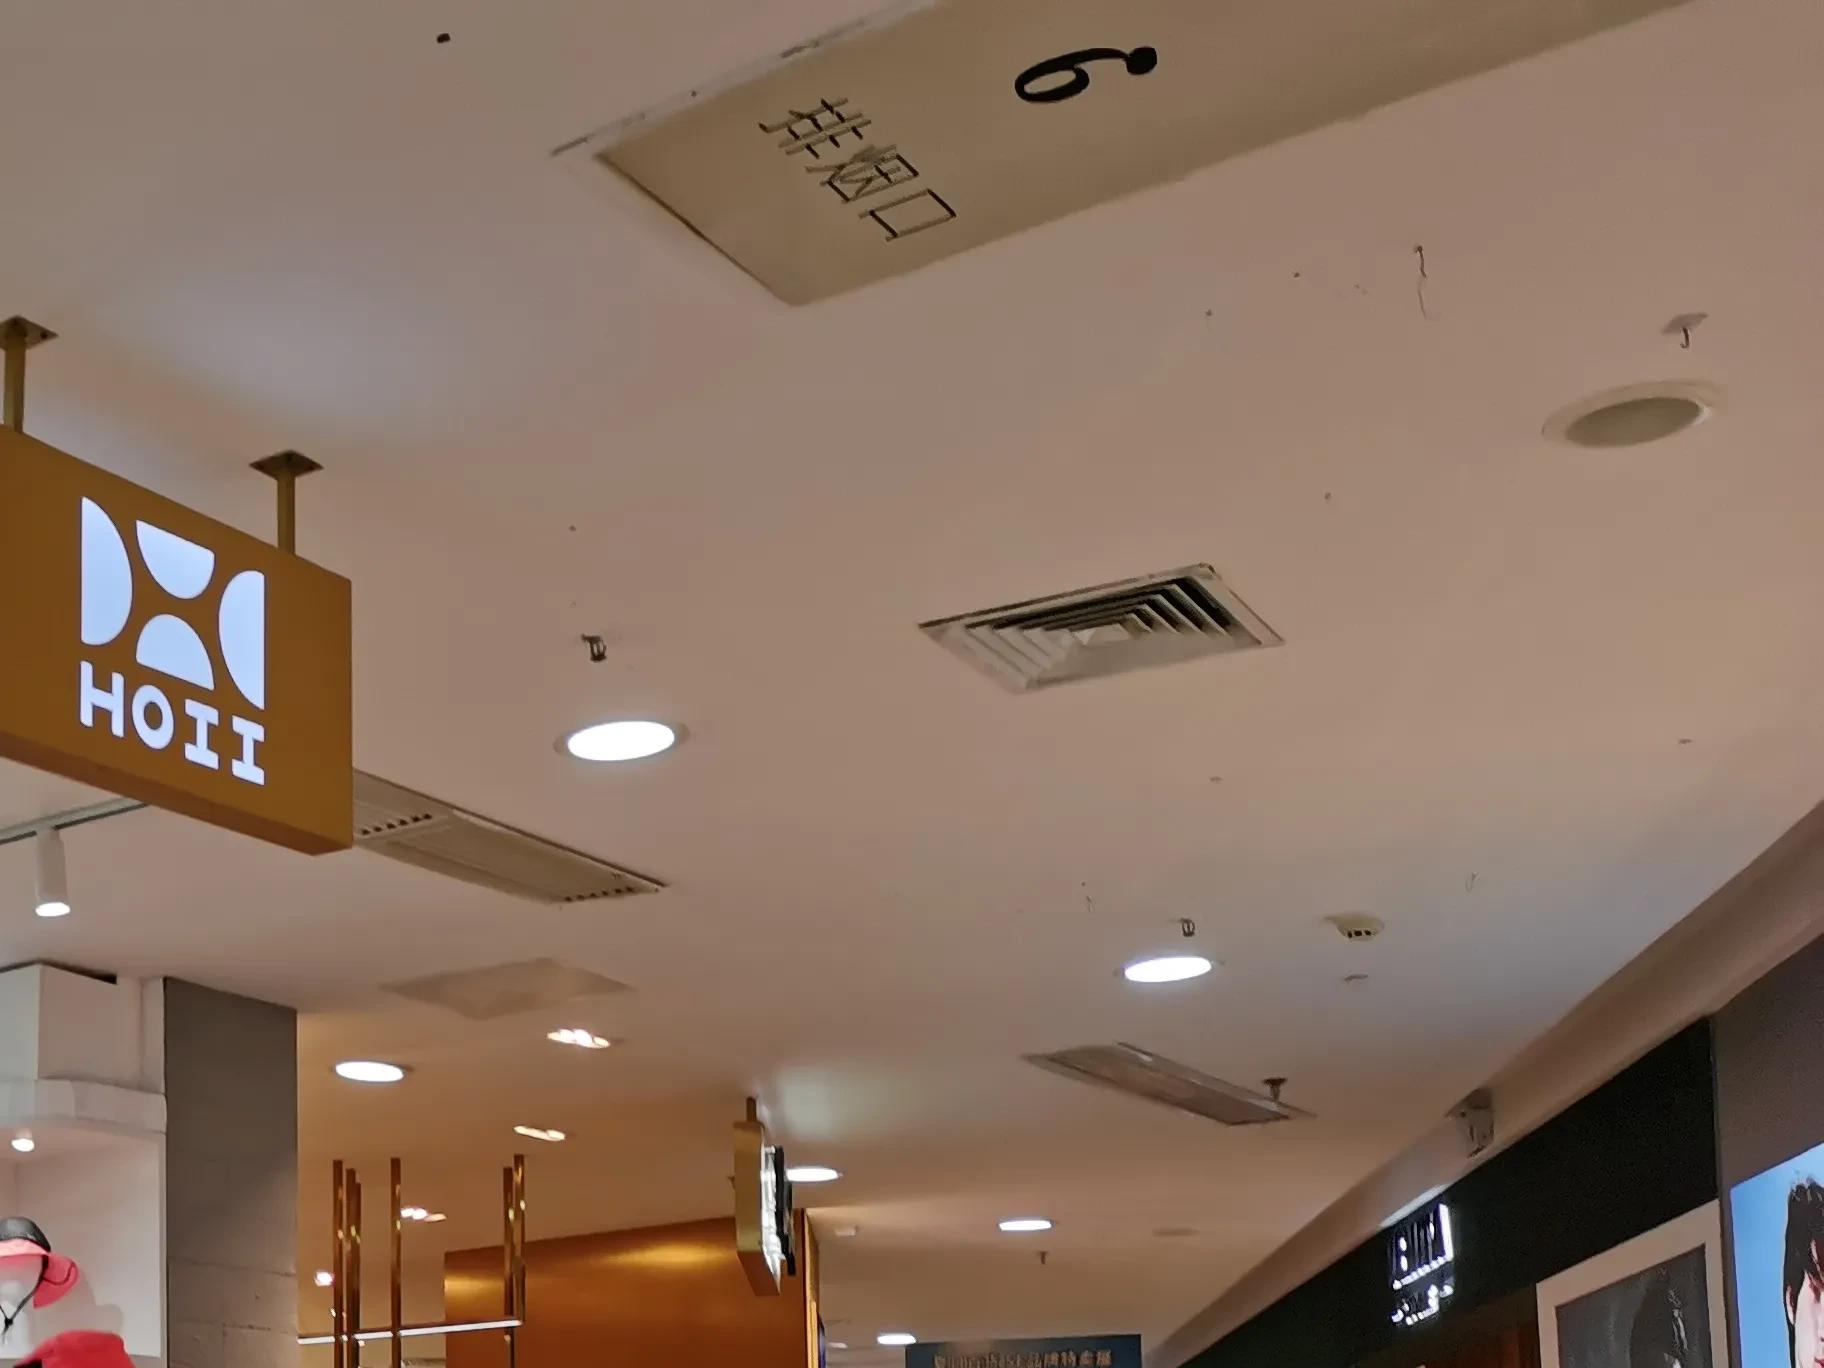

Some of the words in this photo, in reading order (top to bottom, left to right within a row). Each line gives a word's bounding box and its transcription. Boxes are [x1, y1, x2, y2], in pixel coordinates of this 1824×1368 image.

[758, 97, 957, 242] 排烟口
[79, 660, 266, 787] HOII
